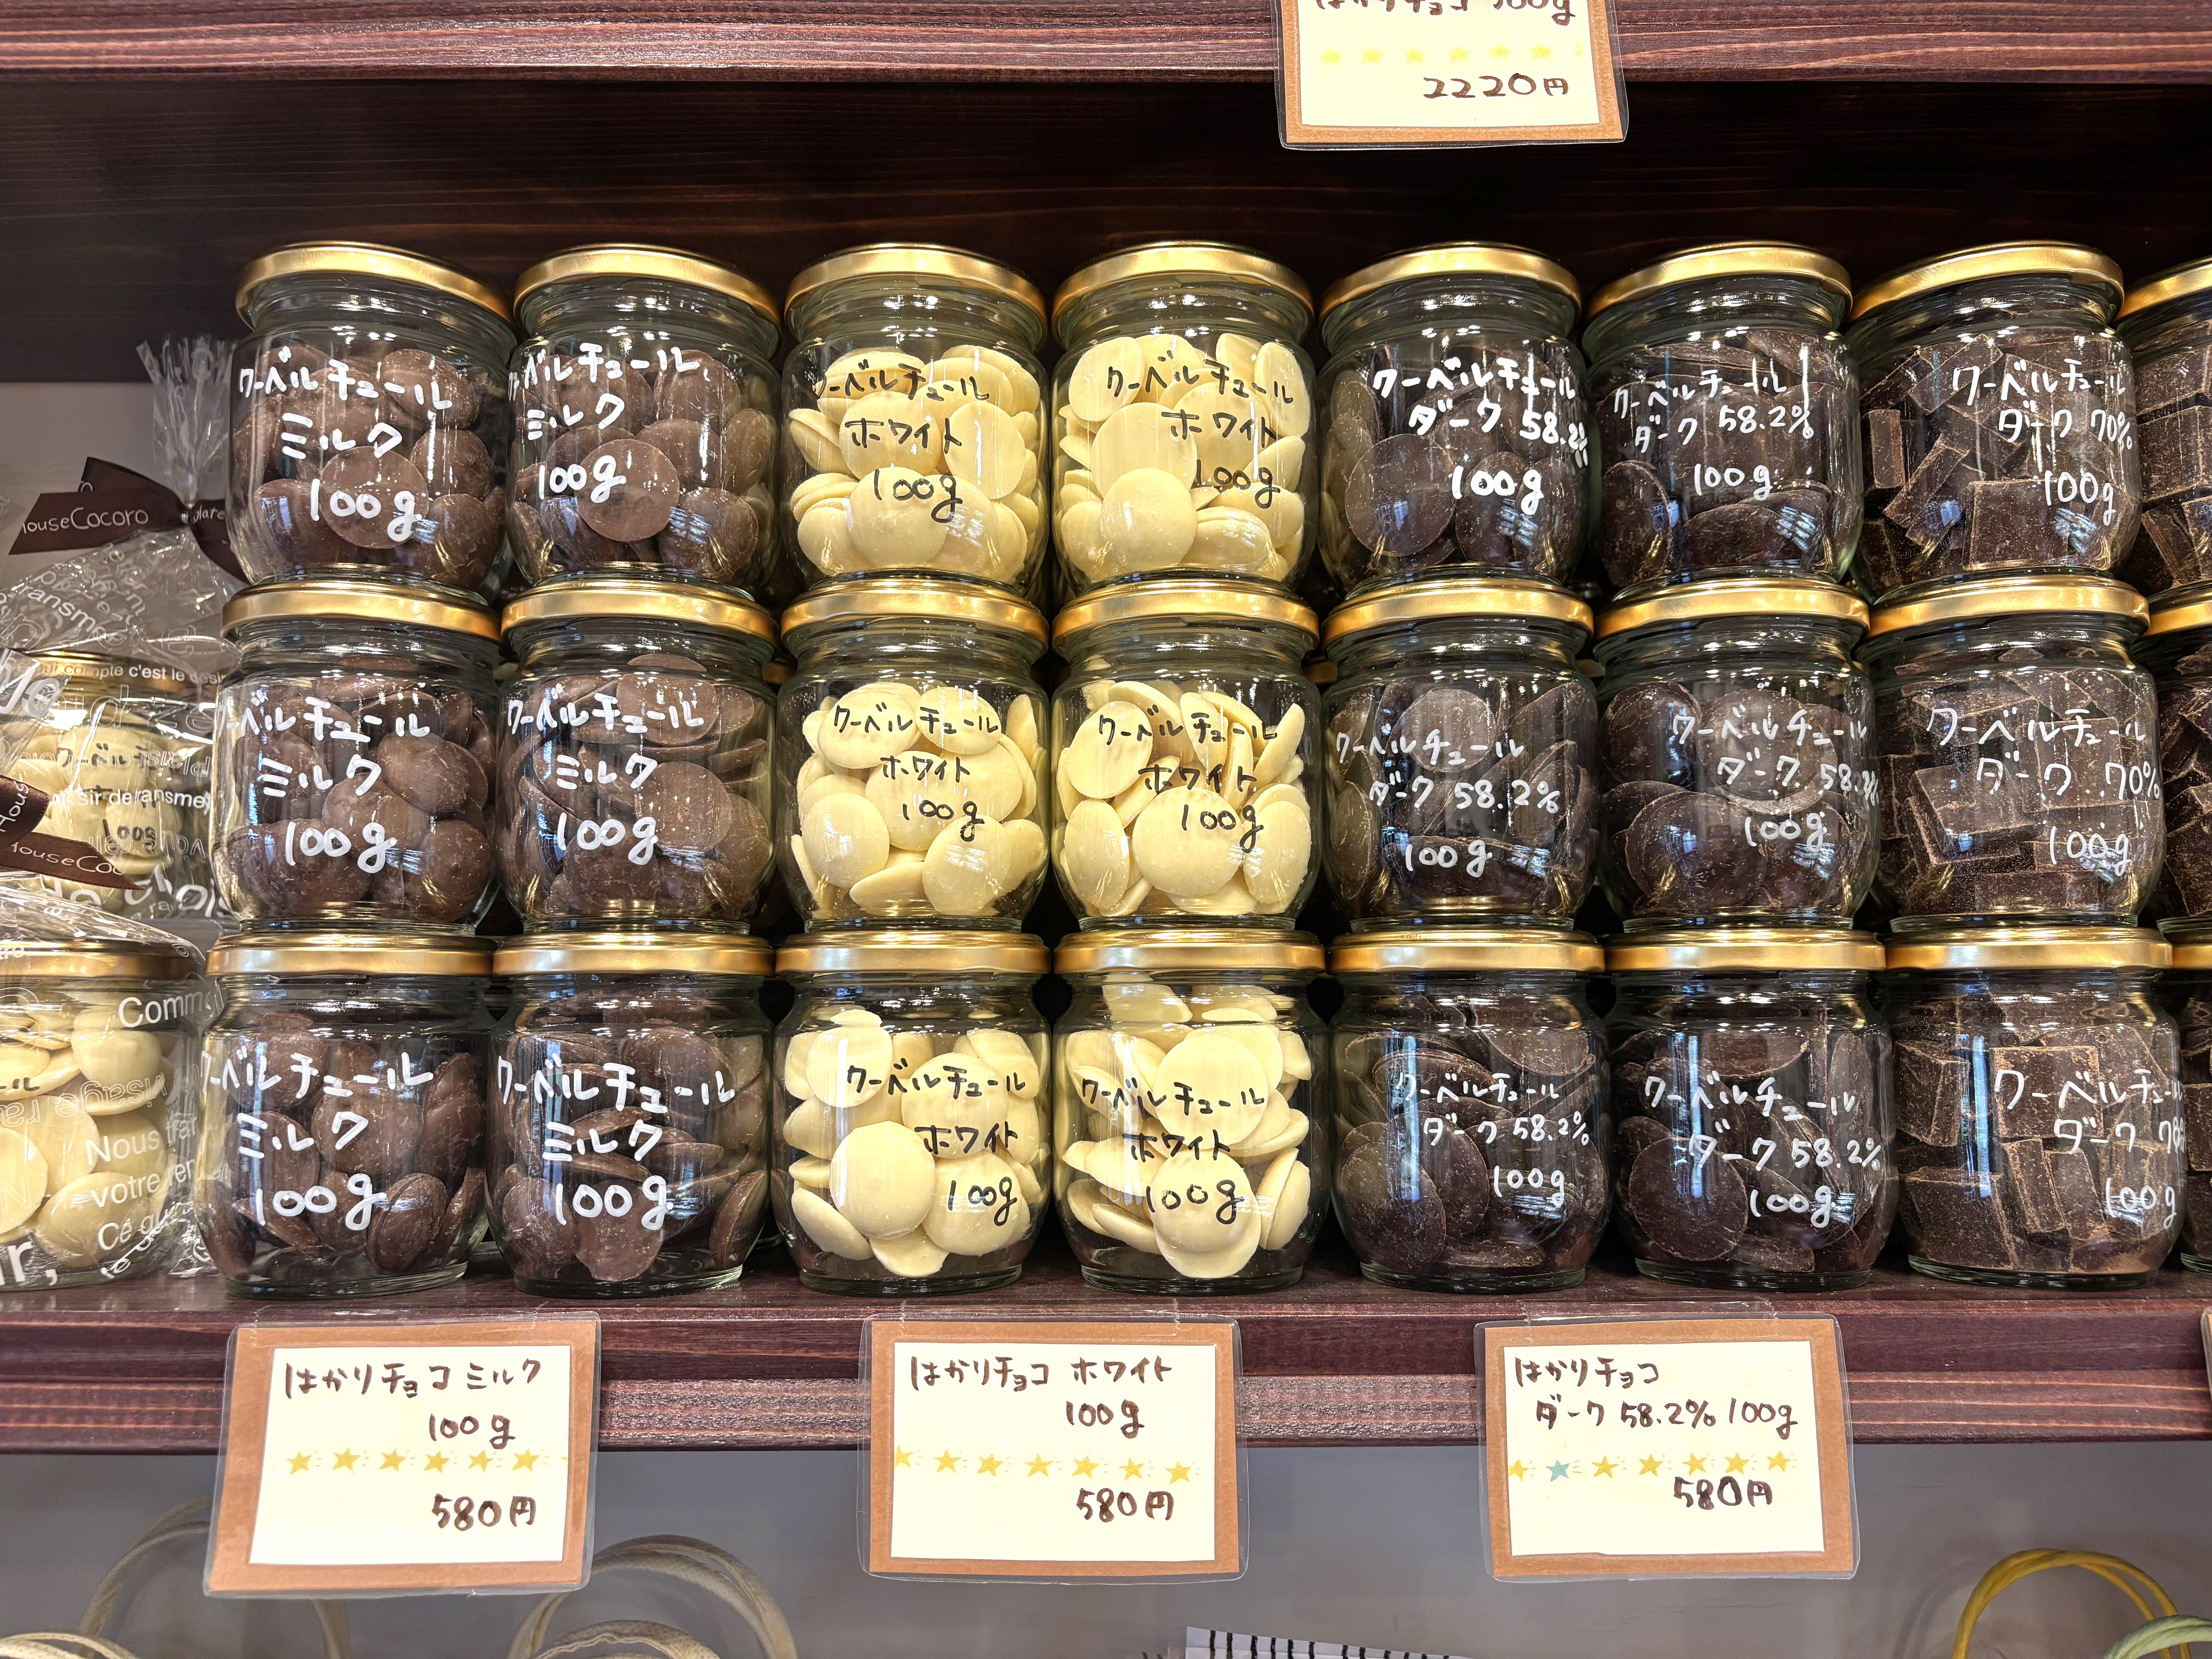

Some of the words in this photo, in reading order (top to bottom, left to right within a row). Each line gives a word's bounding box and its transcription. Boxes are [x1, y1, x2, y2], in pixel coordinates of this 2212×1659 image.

[1423, 73, 1568, 99] 2220円
[239, 345, 452, 410] クーベルチュール
[1107, 350, 1293, 404] クーベルチュール
[1614, 369, 1787, 419] クーベルチュール
[1952, 358, 2126, 406] クーベルチュール
[282, 412, 402, 459] ミルク
[527, 393, 625, 441] ミルク
[844, 418, 962, 454] ホワイト
[1161, 409, 1277, 448] ホワイト
[1408, 398, 1501, 436] ダーク
[1635, 414, 1698, 453] ダーク
[1718, 404, 1814, 440] 58.2%
[1998, 400, 2073, 443] ダーク
[539, 455, 627, 503] 100g
[874, 469, 963, 524] 100g
[1196, 459, 1281, 509] 100g
[1451, 465, 1544, 515] 100g
[1694, 463, 1773, 501] 100g
[2045, 469, 2117, 526] 100g
[311, 478, 422, 542] 100g
[129, 664, 167, 680] c'est
[172, 667, 185, 682] le
[508, 683, 704, 735] クーベルチュール
[834, 702, 999, 735] クーベルチュール
[1099, 704, 1277, 745] クーベルチュール
[1673, 704, 1867, 746] クーベルチュール
[1926, 706, 2146, 747] クーベルチュール
[1336, 722, 1524, 764] クーベルチュール
[262, 754, 381, 798] ミルク
[556, 752, 658, 790] ミルク
[880, 755, 970, 783] ホワイト
[1138, 764, 1257, 795] ホワイト
[1717, 747, 1801, 787] ダーク
[1976, 750, 2072, 797] ダーク
[2105, 761, 2160, 800] 70%
[109, 789, 132, 806] de
[1369, 770, 1434, 809] ダーク
[1454, 779, 1560, 814] 58.2%
[556, 812, 658, 865] 100g
[903, 799, 985, 842] 100g
[1182, 804, 1264, 854] 100g
[1744, 812, 1828, 852] 100g
[285, 821, 398, 874] 100g
[1405, 840, 1493, 878] 100g
[2050, 825, 2131, 877] 100g
[498, 1053, 735, 1114] クーベルチュール
[847, 1058, 1026, 1100] クーベルチュール
[1082, 1077, 1265, 1120] クーベルチュール
[1395, 1072, 1559, 1103] クーベルチュール
[1645, 1070, 1855, 1121] クーベルチュール
[85, 1130, 160, 1166] Nous
[237, 1111, 369, 1159] ミルク
[542, 1119, 663, 1162] ミルク
[914, 1120, 1018, 1155] ホワイト
[1122, 1129, 1231, 1163] ホワイト
[1423, 1112, 1497, 1146] ダーク
[1512, 1111, 1589, 1146] 58.2%
[1688, 1118, 1777, 1171] ダーク
[1792, 1137, 1881, 1171] 58.2%
[2054, 1116, 2136, 1154] ダーク
[90, 1173, 160, 1208] votre
[256, 1173, 388, 1231] 100g
[555, 1175, 674, 1231] 100g
[948, 1176, 1017, 1227] 100g
[1145, 1179, 1245, 1225] 100g
[1493, 1165, 1565, 1208] 100g
[1750, 1185, 1837, 1228] 100g
[2106, 1177, 2177, 1230] 100g
[285, 1362, 451, 1399] はかりチョコ
[466, 1357, 541, 1390] ミルク
[911, 1355, 1049, 1392] はかりチョコ
[1070, 1355, 1173, 1384] ホワイト
[1515, 1356, 1659, 1389] はかりチョコ
[429, 1412, 516, 1450] 100g
[1066, 1399, 1145, 1439] 100g
[1535, 1393, 1605, 1430] ダーク
[1621, 1398, 1716, 1429] 58.2%
[1728, 1397, 1798, 1440] 100g
[431, 1493, 537, 1532] 580円
[1076, 1487, 1174, 1523] 580円
[1673, 1475, 1773, 1510] 580円
